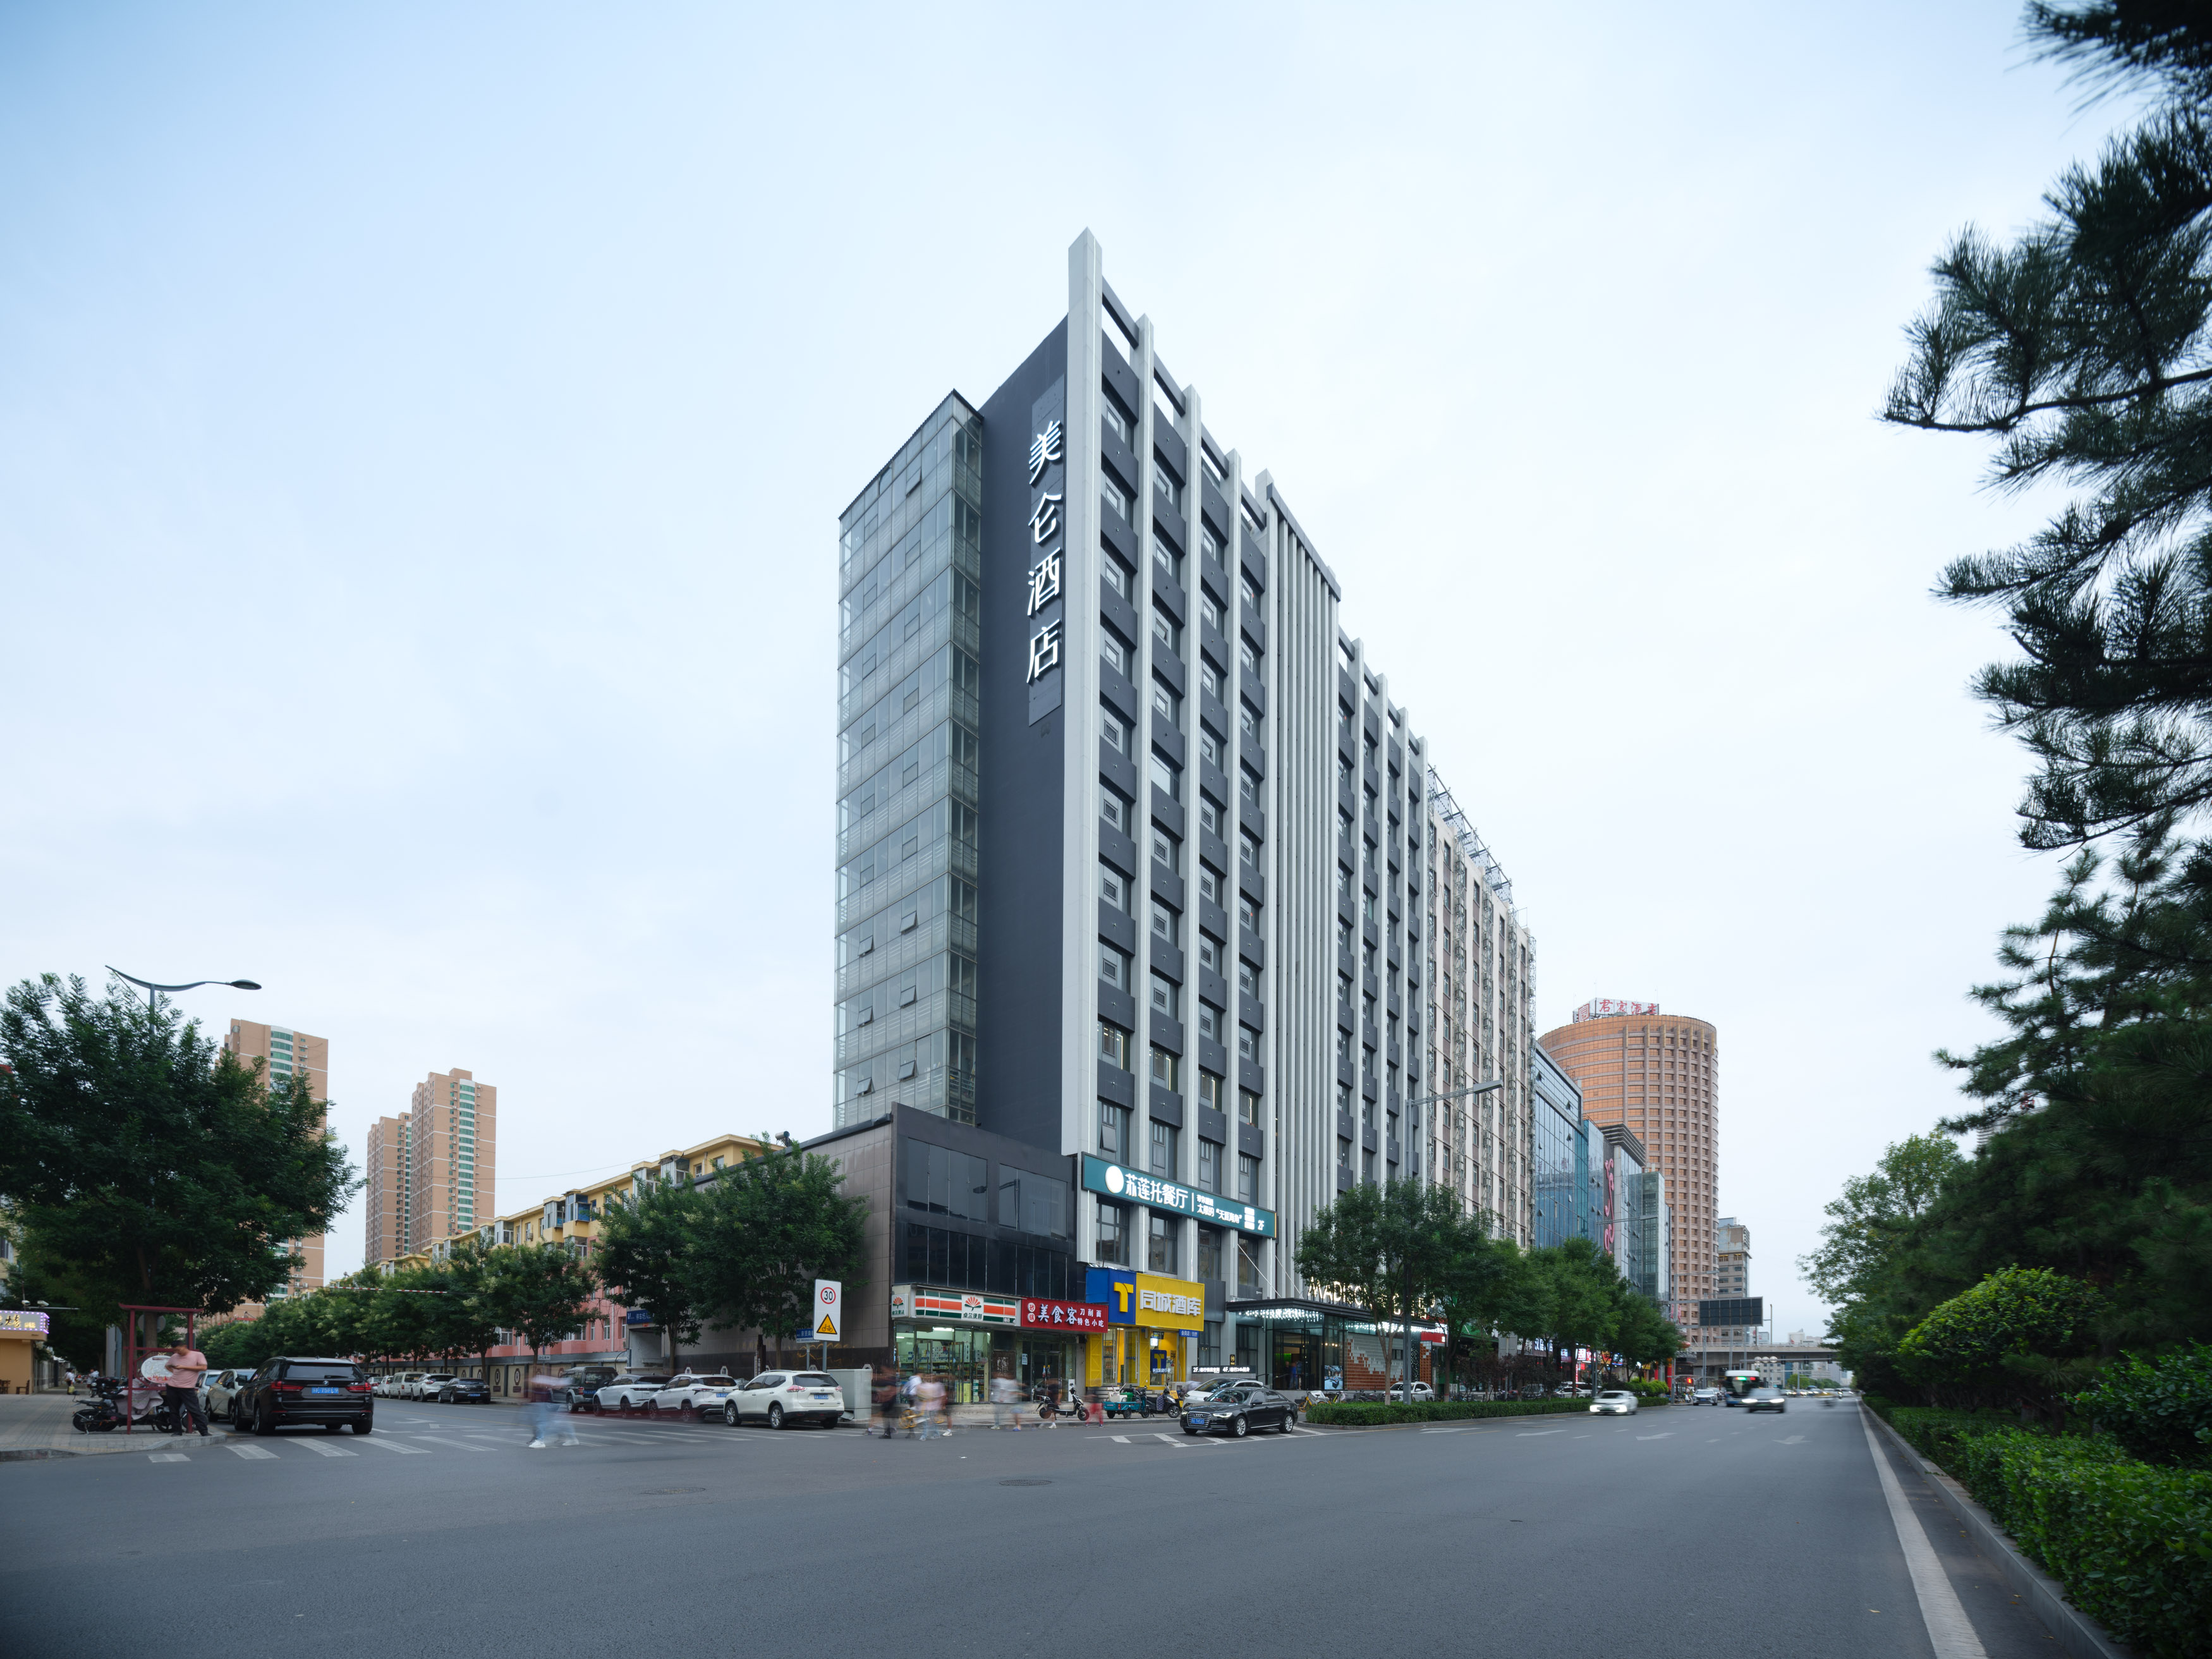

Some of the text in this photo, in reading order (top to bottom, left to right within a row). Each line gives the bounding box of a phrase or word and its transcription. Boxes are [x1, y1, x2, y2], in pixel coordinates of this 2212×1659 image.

[1027, 419, 1062, 683] 美仑酒店
[823, 1291, 833, 1301] 30
[1139, 1289, 1201, 1316] 同城酒库
[1038, 1303, 1078, 1325] 美食客
[1079, 1308, 1102, 1318] 刀削面
[1077, 1317, 1104, 1328] 特色小吃
